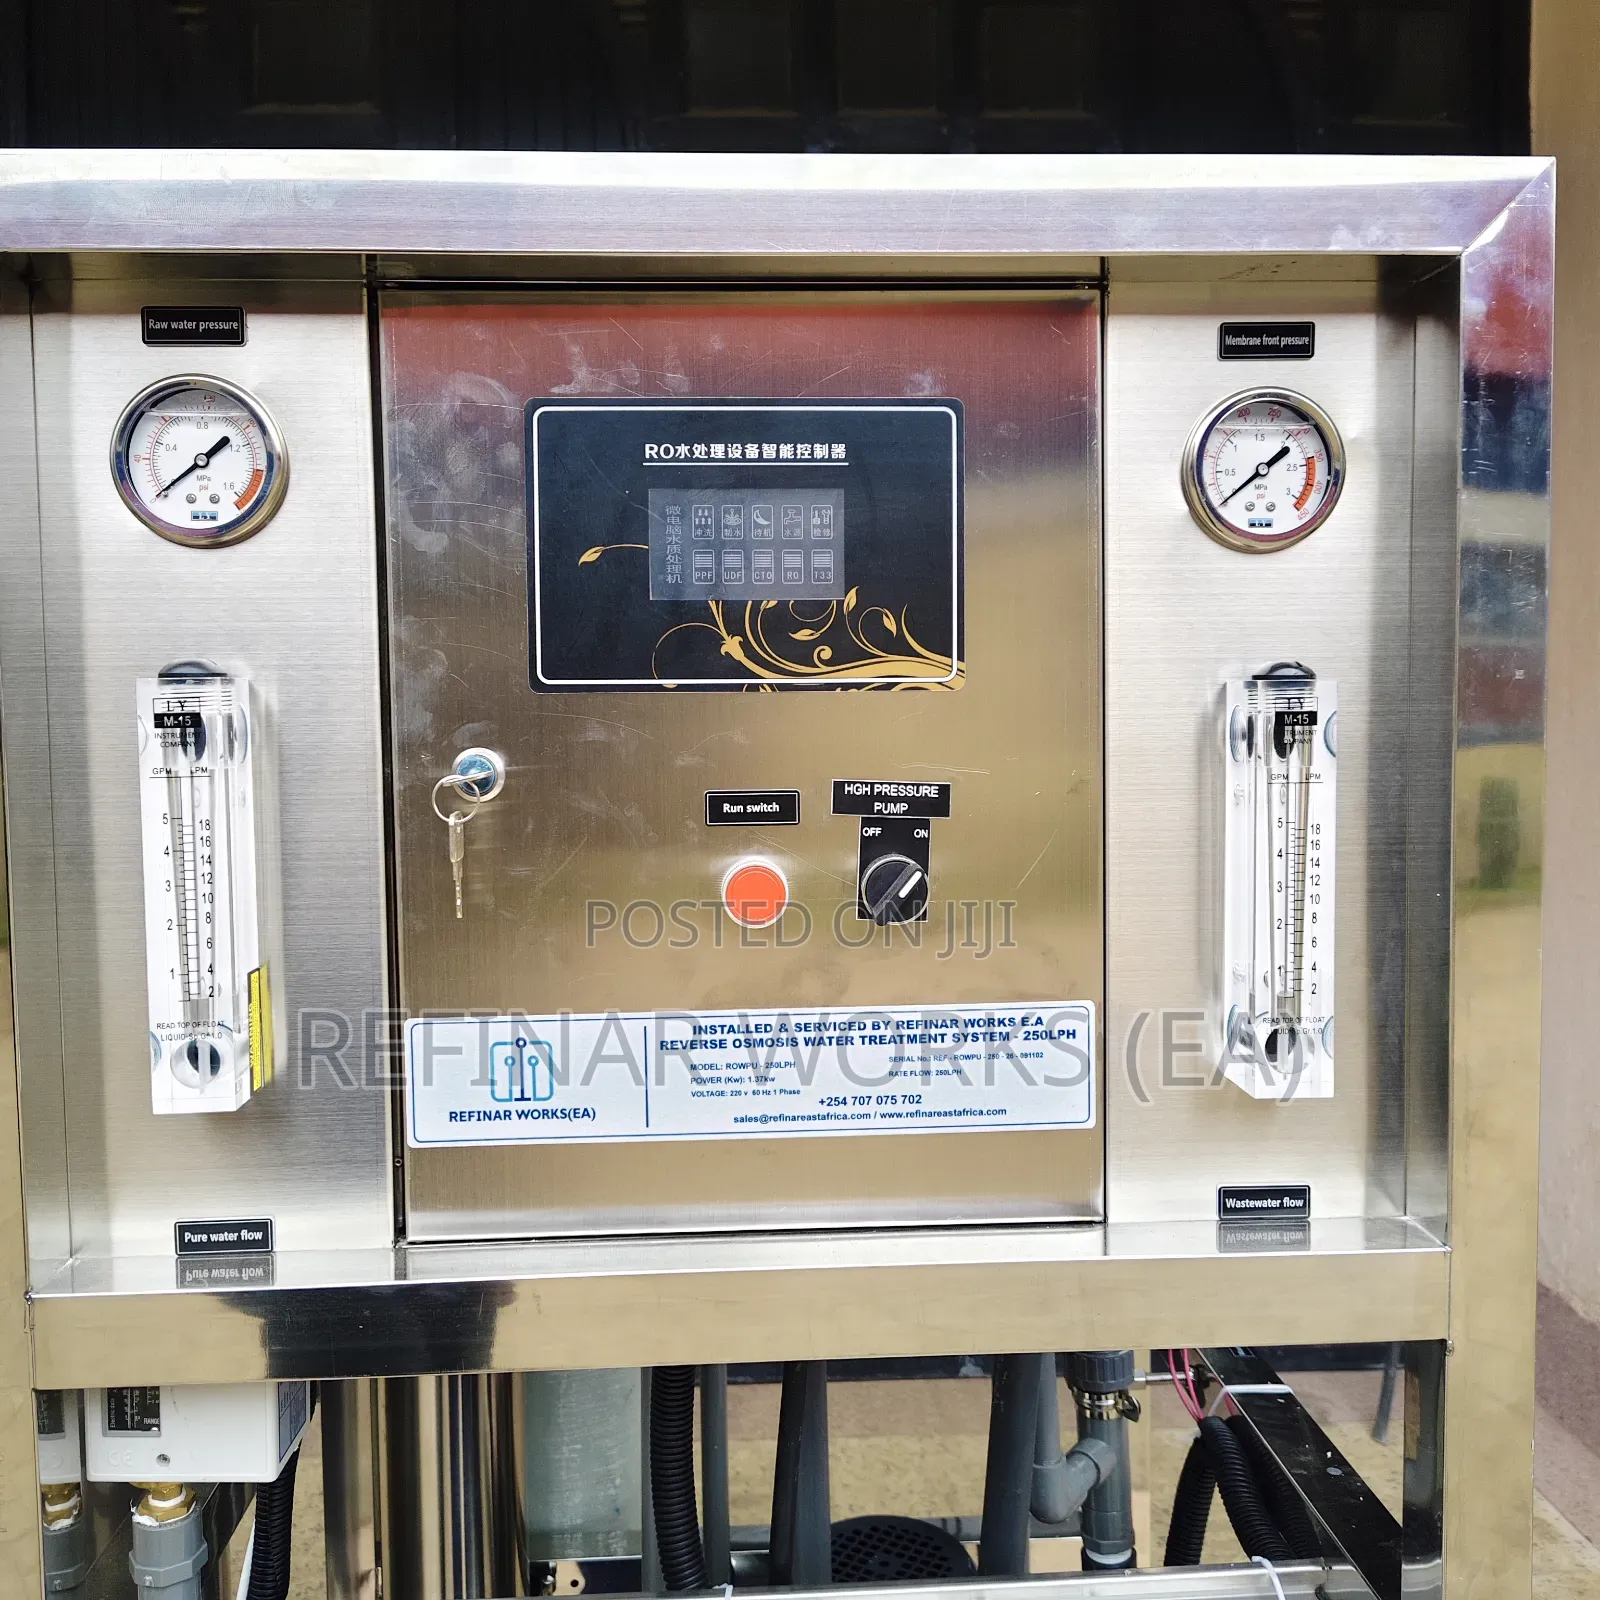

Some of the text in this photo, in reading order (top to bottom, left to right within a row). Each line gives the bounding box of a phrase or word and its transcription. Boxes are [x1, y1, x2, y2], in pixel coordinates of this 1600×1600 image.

[148, 318, 239, 332] Raw water pressure
[1225, 333, 1310, 348] Membrane front pressure
[1237, 407, 1251, 418] 200
[1267, 407, 1282, 418] 250
[196, 421, 209, 430] 0.8
[1254, 433, 1265, 442] 1.5
[165, 443, 177, 452] 0.4
[229, 443, 241, 453] 1.2
[644, 442, 847, 460] RO水处理设备智能控制器
[133, 454, 142, 464] 40
[1224, 468, 1236, 476] 0.5
[1286, 463, 1298, 472] 2.5
[196, 474, 211, 482] MPa
[199, 484, 209, 492] psi
[223, 481, 235, 491] 1.6
[1254, 483, 1268, 491] MPa
[1285, 487, 1291, 496] 3
[1256, 492, 1266, 500] psi
[1297, 507, 1310, 521] 450
[695, 528, 712, 538] 冲洗
[724, 528, 742, 538] 制水
[754, 528, 772, 538] 待机
[784, 528, 802, 538] 水源
[813, 528, 831, 538] 检修
[665, 505, 683, 584] 微电脑水质处理机
[695, 571, 713, 580] PPF
[724, 571, 742, 580] UDF
[787, 571, 800, 580] RO
[814, 571, 832, 580] T33
[163, 715, 192, 727] M-15
[1284, 713, 1309, 725] M-15
[152, 767, 172, 775] GPM
[190, 766, 208, 774] LPM
[1270, 773, 1288, 781] GPM
[844, 783, 940, 798] HGH PRESSURE
[723, 801, 780, 813] Run switch
[873, 802, 909, 815] PUMP
[162, 812, 169, 825] 5
[1276, 817, 1283, 829] 5
[200, 819, 211, 831] 18
[1310, 823, 1321, 835] 18
[862, 826, 882, 837] OFF
[913, 828, 929, 839] ON
[200, 835, 212, 848] 16
[1310, 839, 1321, 851] 16
[163, 845, 170, 857] 4
[1276, 847, 1283, 859] 4
[201, 854, 212, 866] 14
[1309, 857, 1321, 869] 14
[201, 872, 213, 885] 12
[1309, 874, 1321, 887] 12
[165, 880, 172, 892] 3
[1277, 881, 1283, 893] 3
[202, 893, 214, 905] 10
[1309, 893, 1321, 905] 10
[205, 912, 212, 924] 8
[1276, 918, 1283, 930] 2
[1311, 912, 1318, 924] 8
[167, 919, 173, 931] 2
[206, 937, 213, 949] 6
[1311, 936, 1318, 948] 6
[207, 963, 214, 974] 4
[1277, 965, 1282, 976] 1
[1311, 961, 1317, 973] 4
[170, 968, 175, 980] 1
[208, 986, 214, 998] 2
[1311, 983, 1317, 995] 2
[156, 1022, 176, 1030] READ
[202, 1020, 224, 1028] FLOAT
[692, 1016, 1045, 1036] INSTALLED & SERVICED BY REFINAR WORKS E.A
[160, 1033, 186, 1042] LIQUID
[659, 1028, 1077, 1051] REVERSE OSMOSIS WATER TREATMENT SYSTEM 250LPH
[888, 1055, 915, 1063] SERIAL
[933, 1054, 948, 1062] REF
[690, 1061, 796, 1071] MODEL: ROWPU 250LPH
[909, 1069, 934, 1077] FLOW:
[690, 1075, 776, 1085] POWER (Kw): 1.37kw
[818, 1094, 922, 1107] +254 707 075 702
[448, 1107, 597, 1123] REFINAR WORKS(EA)
[732, 1108, 1007, 1124] sales@refinareastafrica.com www.refinareastafrica.com
[1225, 1196, 1304, 1208] Wastewater flow
[184, 1229, 263, 1243] Pure water flow
[143, 1417, 160, 1425] RANGE
